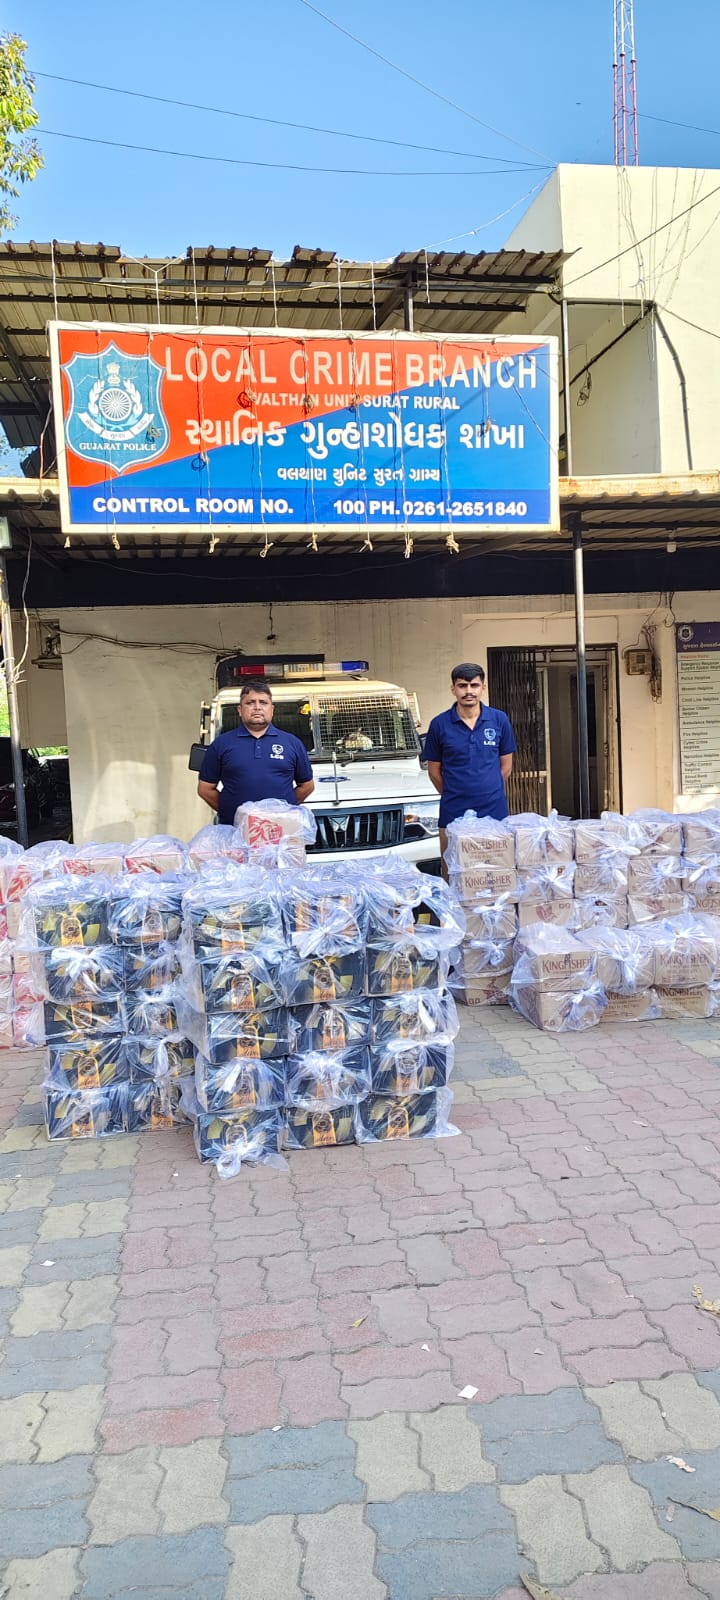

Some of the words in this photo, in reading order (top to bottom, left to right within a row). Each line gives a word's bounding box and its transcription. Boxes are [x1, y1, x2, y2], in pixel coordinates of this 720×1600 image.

[165, 346, 277, 384] LOCAL
[289, 350, 393, 386] CRIME
[406, 353, 537, 389] BRANCH
[250, 393, 319, 407] VALTHAN
[323, 393, 359, 407] UNIT
[363, 395, 410, 409] SURAT
[413, 396, 460, 410] RURAL
[185, 409, 286, 448] સ્થાનિક
[300, 411, 446, 460] ગુન્હાશોધક
[459, 423, 525, 449] શાખા
[79, 442, 121, 451] GUJARAT
[123, 442, 157, 451] POLICE
[277, 467, 327, 481] વલથાણ
[333, 463, 367, 486] યુનિટ
[373, 468, 403, 486] સુરત
[409, 468, 441, 482] ગ્રામ્ય
[92, 497, 190, 514] CONTROL
[195, 498, 254, 514] ROOM
[259, 499, 294, 514] NO.
[333, 500, 365, 515] 100
[403, 501, 528, 516] 0261-2651840
[461, 839, 508, 853] KINGFISHER
[464, 875, 511, 888] KINGHER
[660, 952, 710, 966] KINGSHER
